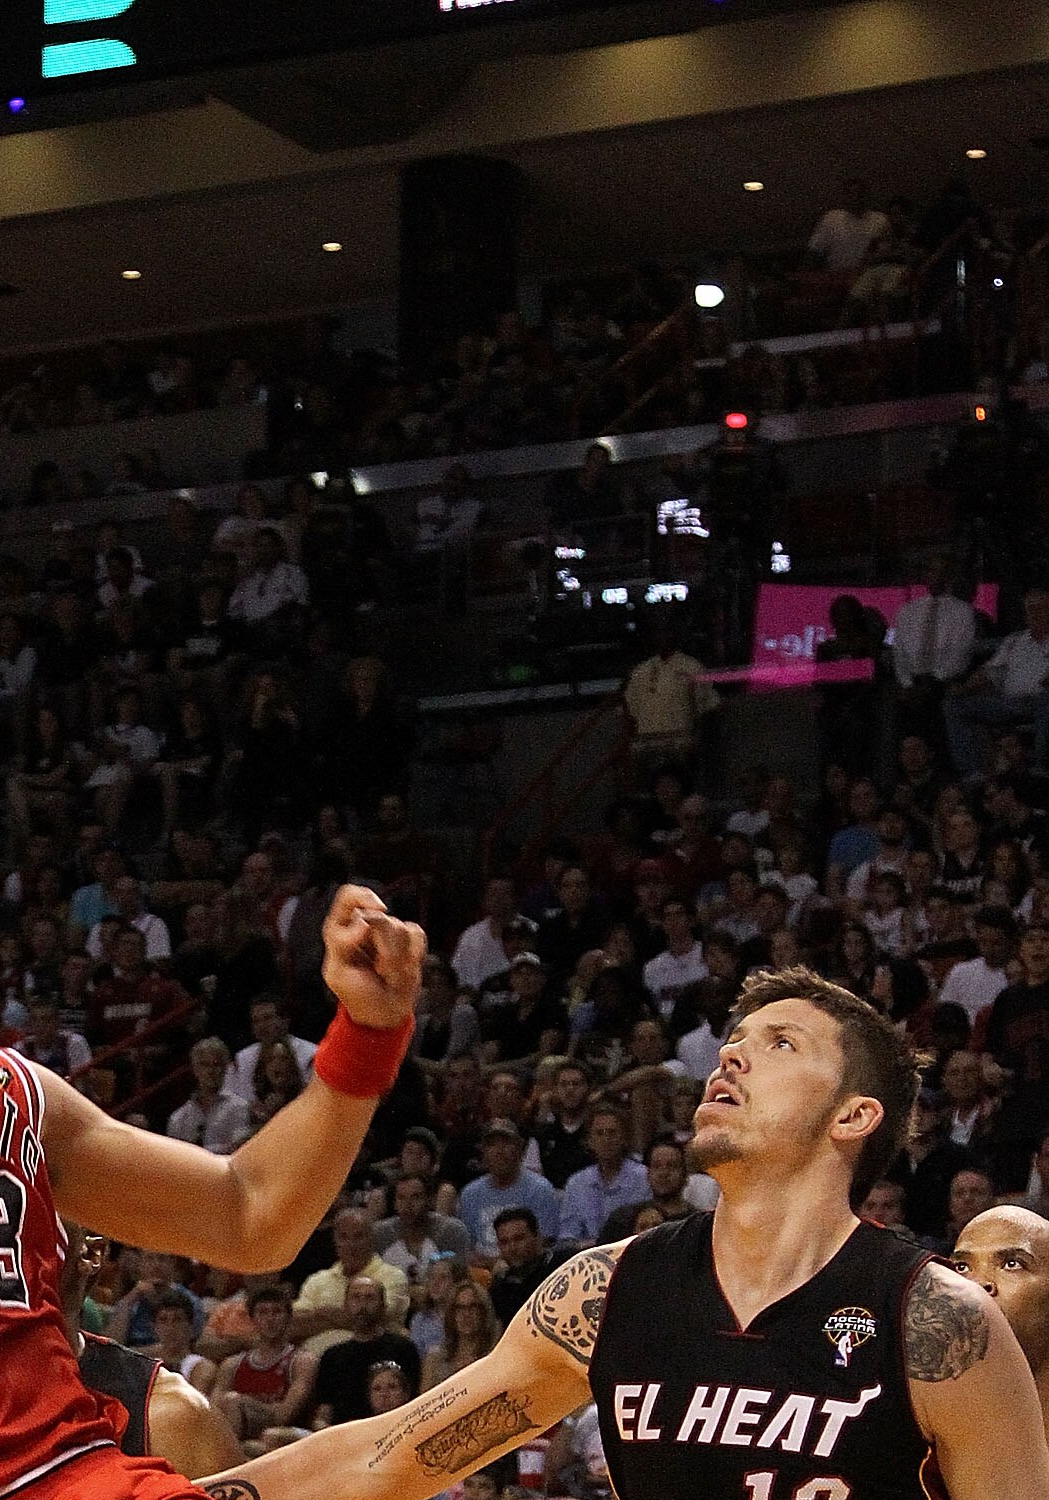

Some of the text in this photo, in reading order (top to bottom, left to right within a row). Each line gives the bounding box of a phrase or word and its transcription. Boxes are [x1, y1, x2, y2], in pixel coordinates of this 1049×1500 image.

[828, 1316, 877, 1327] NOCHE
[824, 1322, 876, 1334] LATINA
[614, 1381, 882, 1457] EL HEAT
